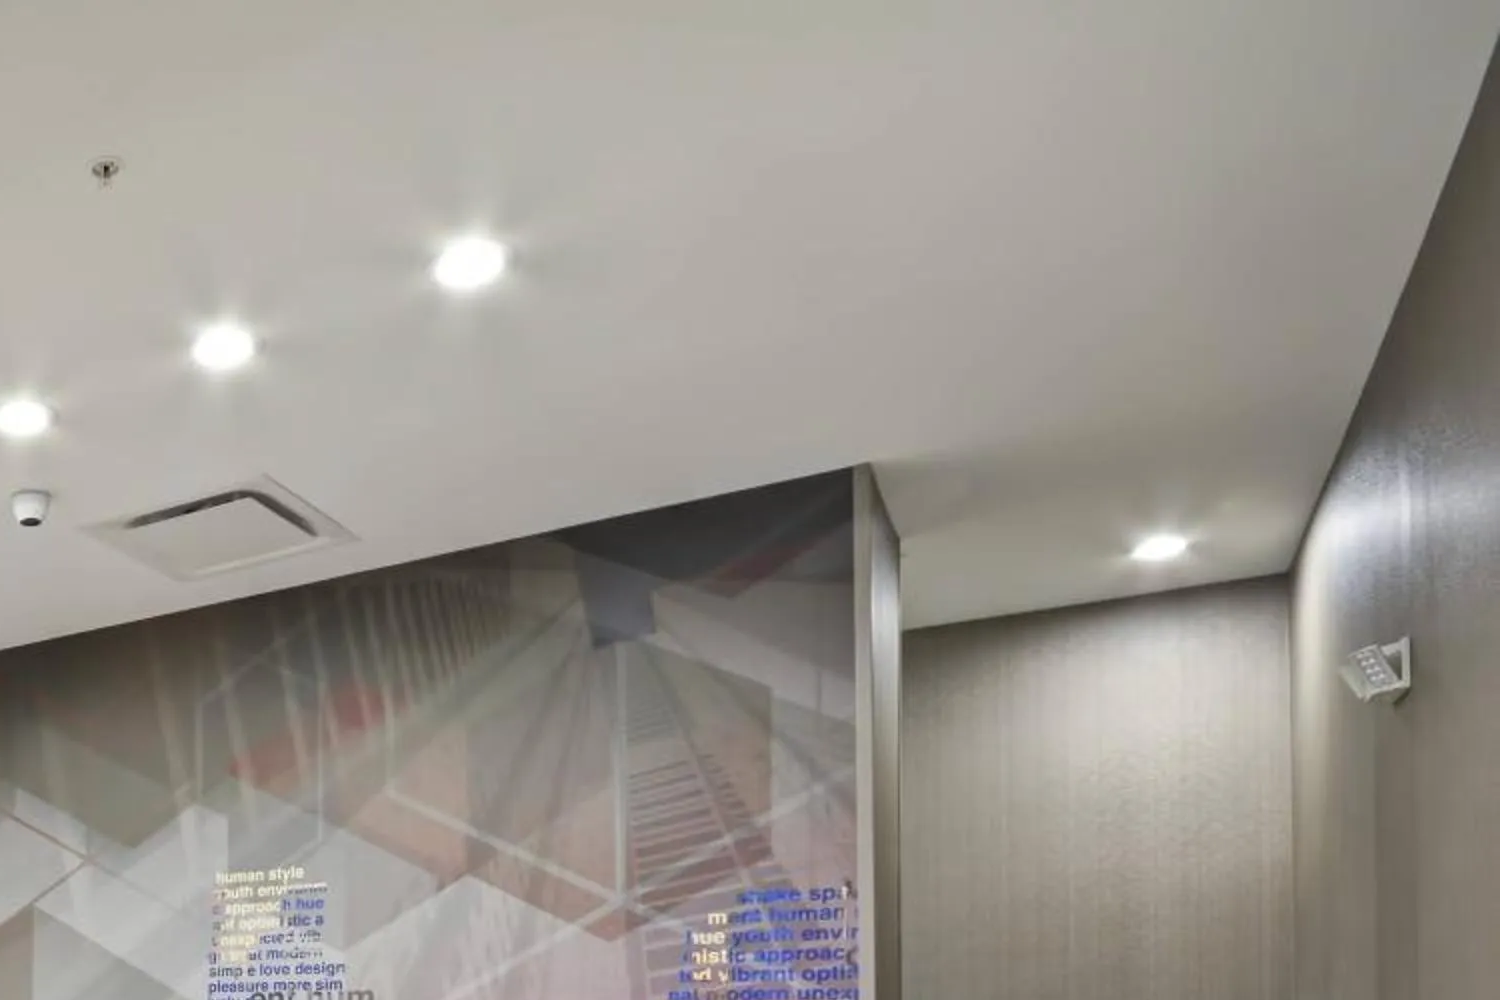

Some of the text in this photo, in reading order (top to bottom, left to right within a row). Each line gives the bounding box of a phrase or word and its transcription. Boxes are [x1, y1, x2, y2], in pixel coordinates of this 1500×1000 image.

[215, 865, 306, 885] human style
[225, 899, 291, 917] approach
[295, 898, 325, 910] hue
[770, 905, 846, 923] human
[686, 929, 726, 945] hue
[259, 961, 291, 977] love
[295, 960, 347, 977] design
[208, 978, 343, 995] pleasure more sim
